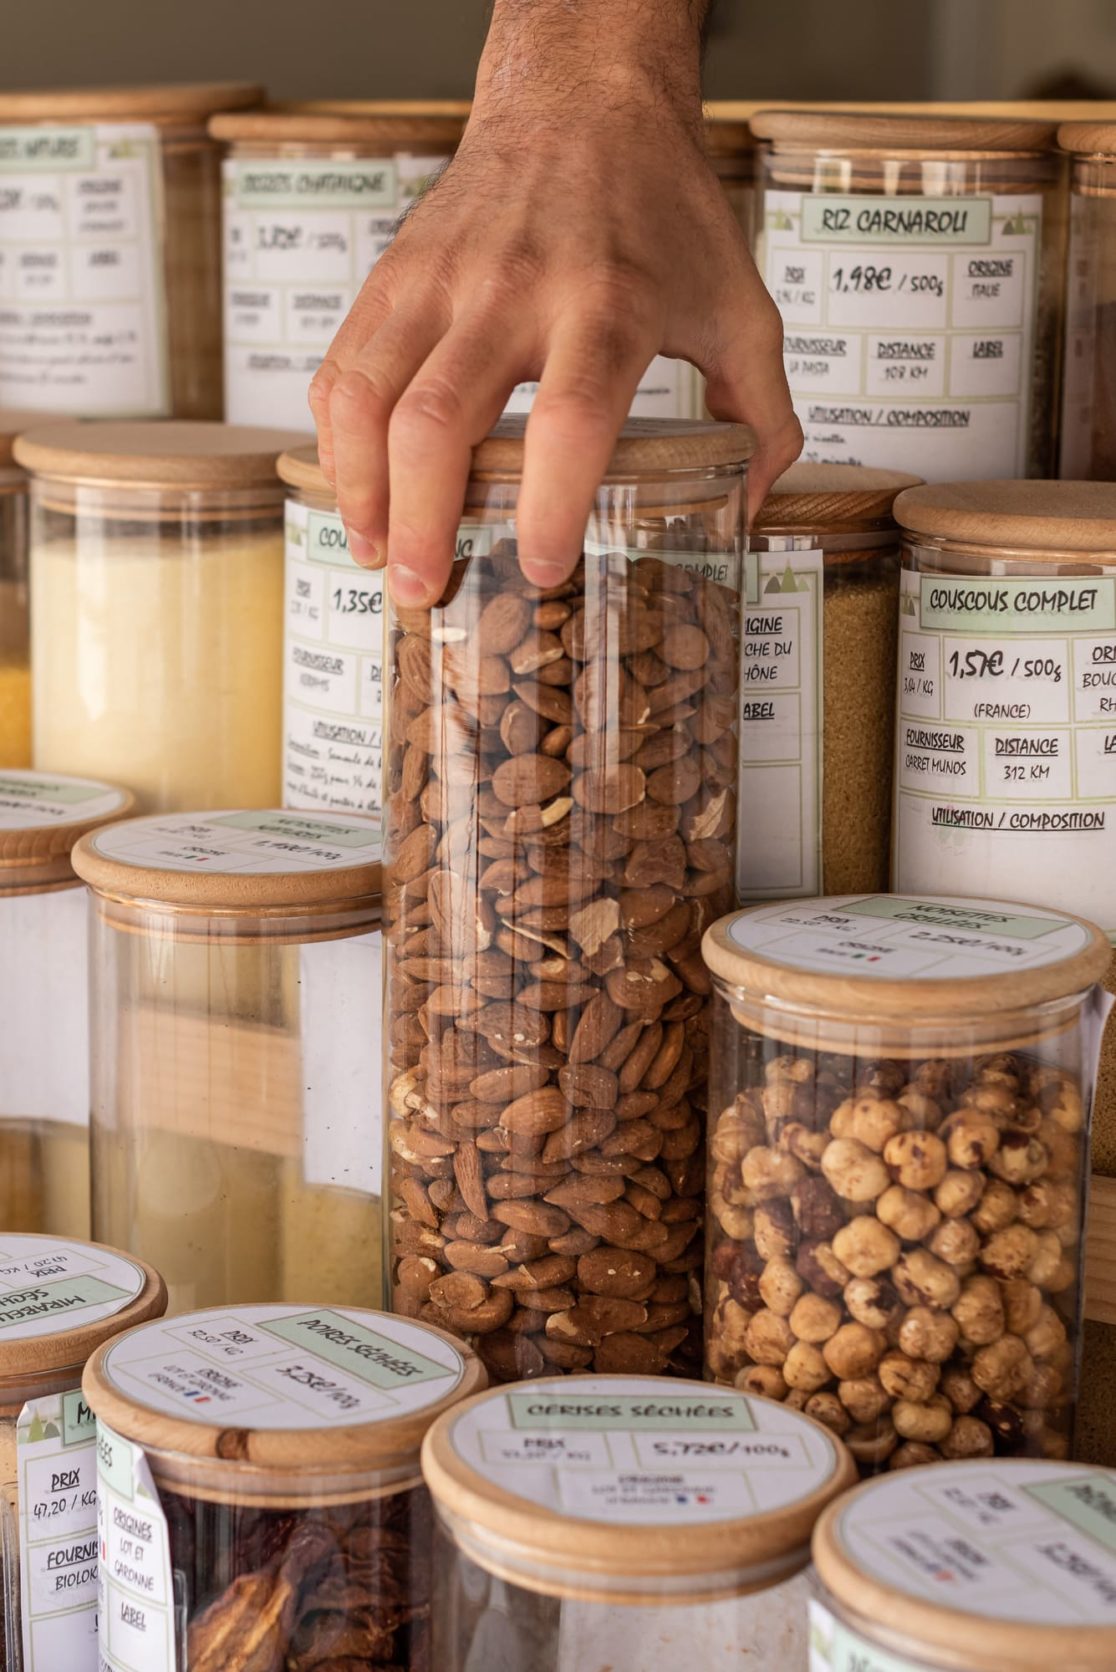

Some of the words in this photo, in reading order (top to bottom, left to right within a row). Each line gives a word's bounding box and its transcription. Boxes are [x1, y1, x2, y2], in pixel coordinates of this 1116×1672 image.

[822, 208, 851, 231] RIZ
[832, 266, 892, 293] 1,98€
[877, 342, 936, 360] DISTANCE
[886, 409, 971, 428] COMPOSITION
[930, 590, 1008, 613] COUSCOUS
[1014, 590, 1099, 613] COMPLET
[774, 642, 793, 656] DU
[910, 652, 925, 671] PRIX
[949, 650, 1004, 679] 1,57€
[1023, 659, 1062, 683] 500g
[923, 680, 934, 696] KG
[973, 703, 1031, 718] (FRANCE)
[906, 728, 965, 752] FOURNISSEUR
[995, 738, 1058, 756] DISTANCE
[932, 758, 967, 776] MUNOS
[1003, 765, 1026, 780] 312
[1030, 766, 1050, 780] KM
[931, 807, 994, 828] UTILISATION
[1009, 812, 1105, 831] COMPOSITION
[28, 1264, 68, 1278] PRIX
[296, 1318, 360, 1346] POIRES
[527, 1403, 622, 1418] CERISES
[51, 1467, 81, 1492] PRIX
[33, 1500, 67, 1519] 47,20
[71, 1494, 78, 1509] /
